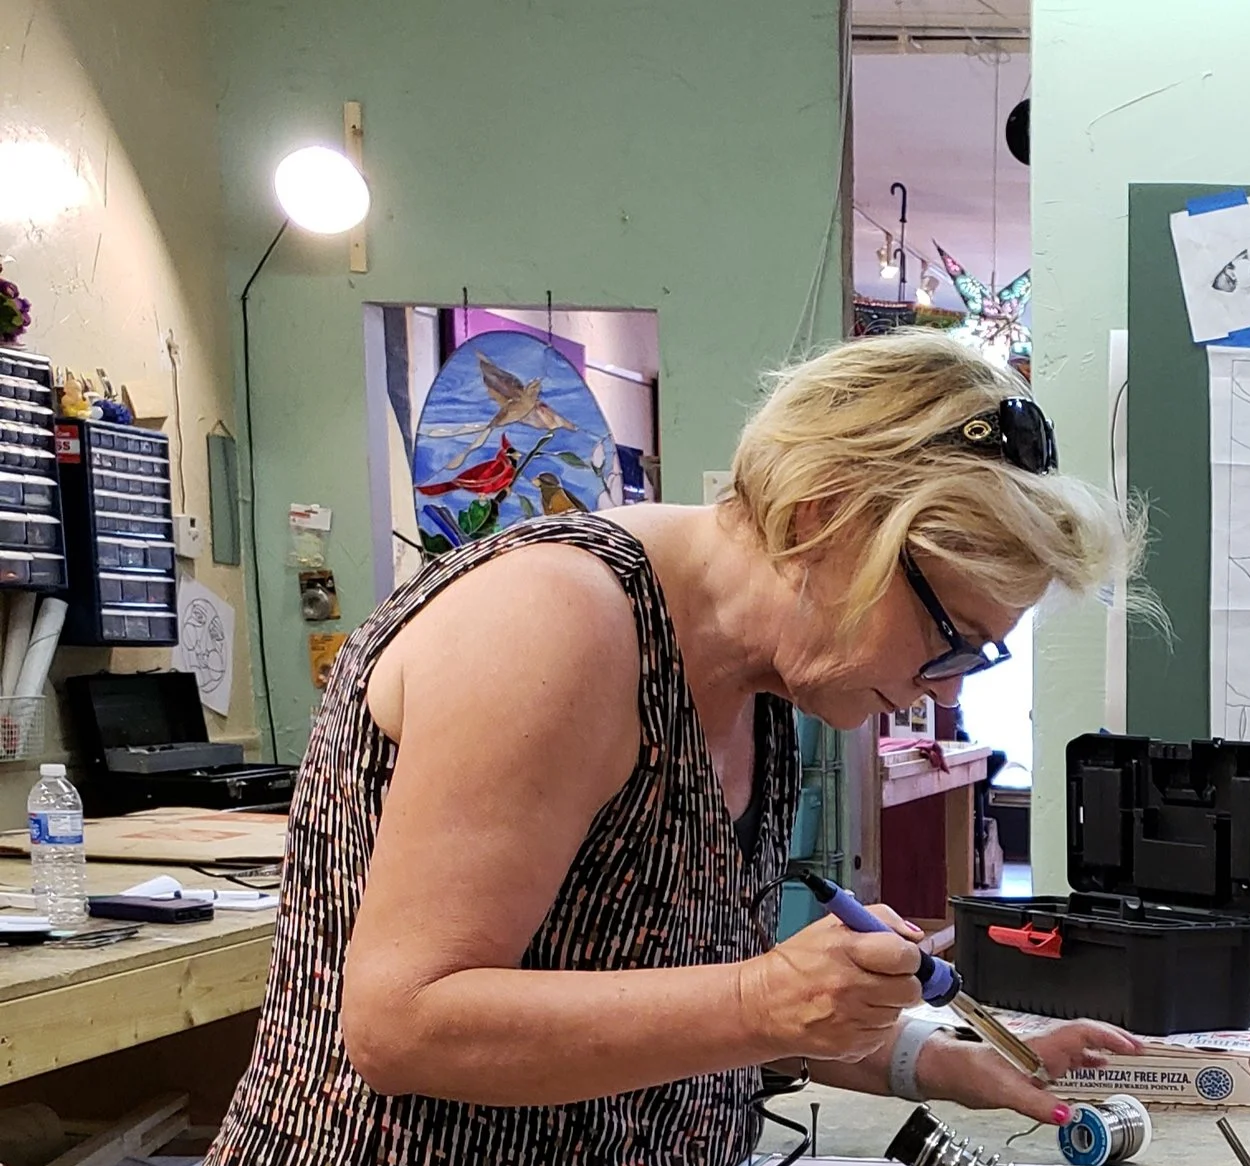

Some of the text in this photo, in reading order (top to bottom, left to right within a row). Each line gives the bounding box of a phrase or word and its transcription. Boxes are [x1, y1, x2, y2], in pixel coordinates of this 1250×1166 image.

[1070, 1068, 1191, 1084] THAN PIZZA? FREE PIZZA.
